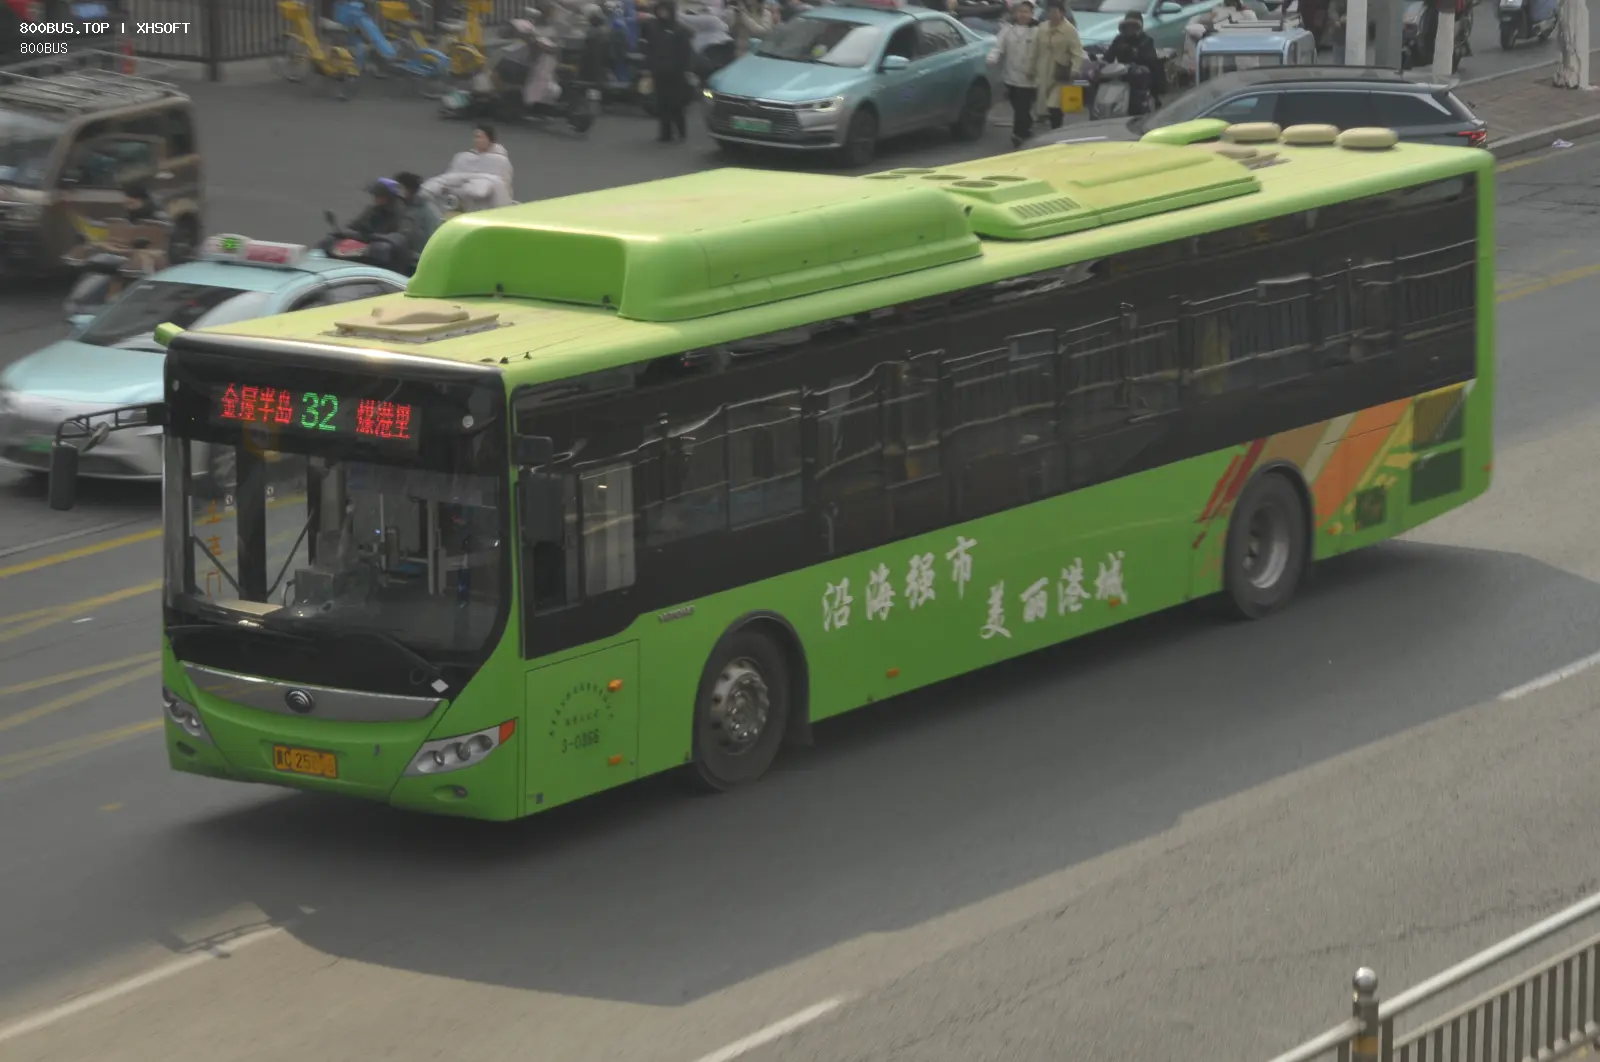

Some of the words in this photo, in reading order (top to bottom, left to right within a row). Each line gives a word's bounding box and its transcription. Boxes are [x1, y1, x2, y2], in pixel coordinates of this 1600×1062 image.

[301, 392, 339, 432] 32
[822, 535, 977, 632] 沿海强市
[980, 550, 1127, 639] 美丽港城
